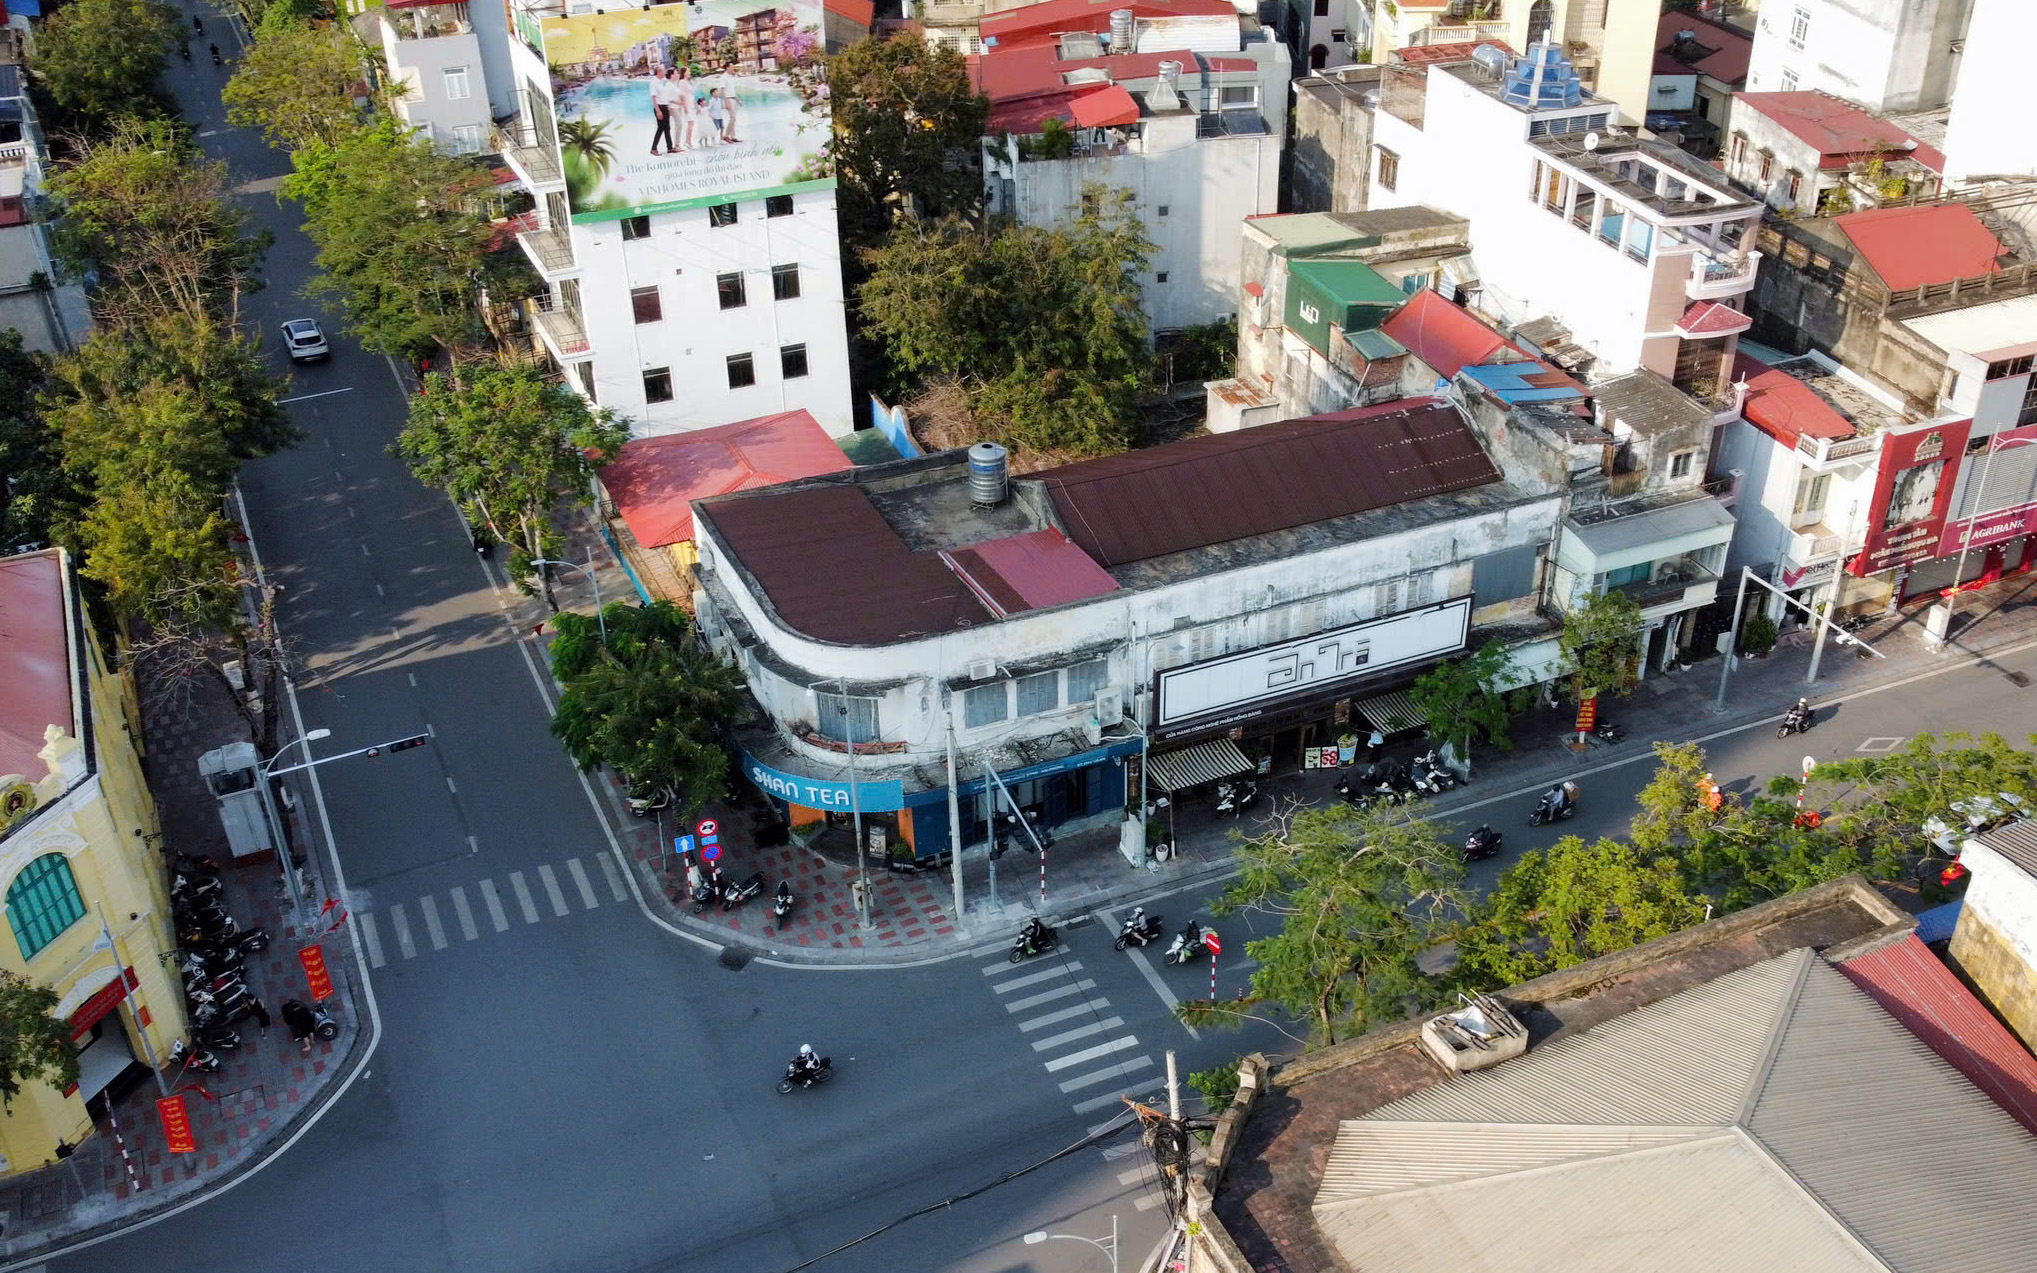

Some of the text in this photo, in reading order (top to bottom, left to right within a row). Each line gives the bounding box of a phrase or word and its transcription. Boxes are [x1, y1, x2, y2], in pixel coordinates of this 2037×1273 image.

[733, 169, 770, 183] ISLAND
[1971, 518, 2026, 540] AGRIBANK
[752, 766, 850, 806] SHAN TEA
